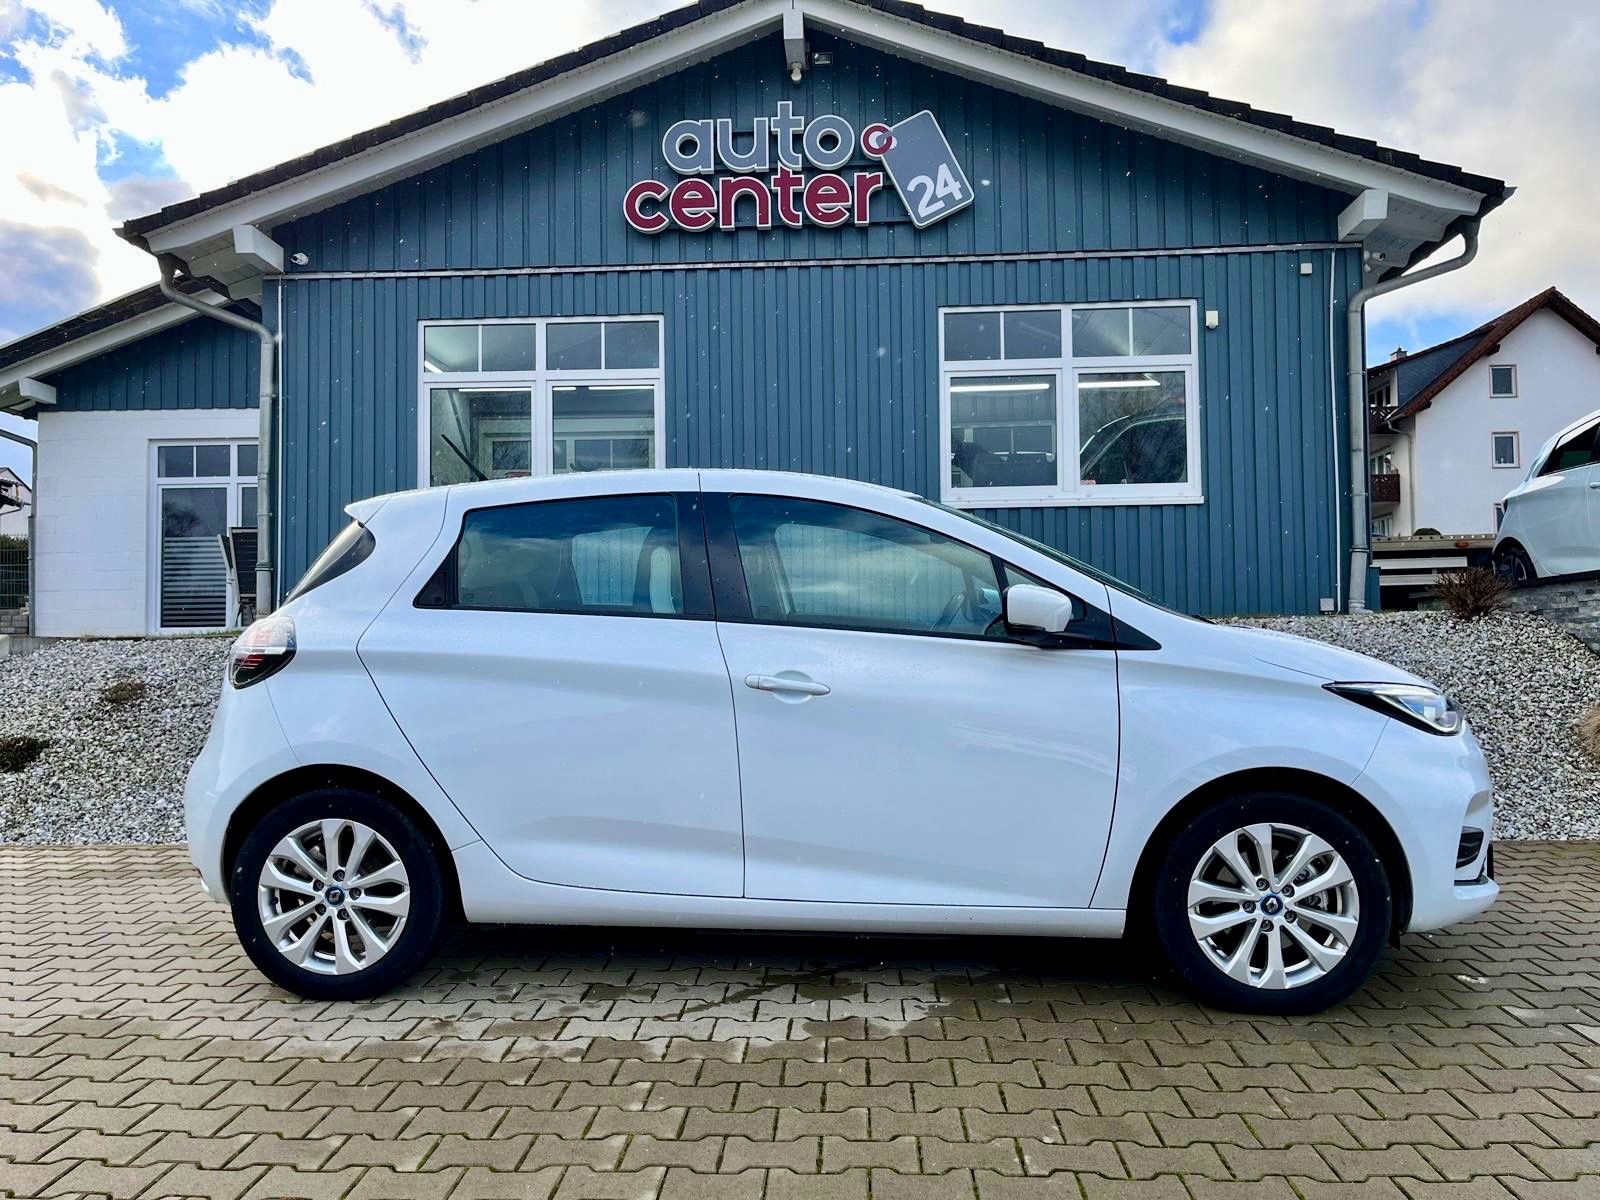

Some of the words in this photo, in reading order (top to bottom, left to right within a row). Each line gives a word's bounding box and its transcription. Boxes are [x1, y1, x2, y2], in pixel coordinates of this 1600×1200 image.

[662, 100, 855, 174] auto
[623, 164, 883, 233] center
[906, 163, 963, 218] 24
